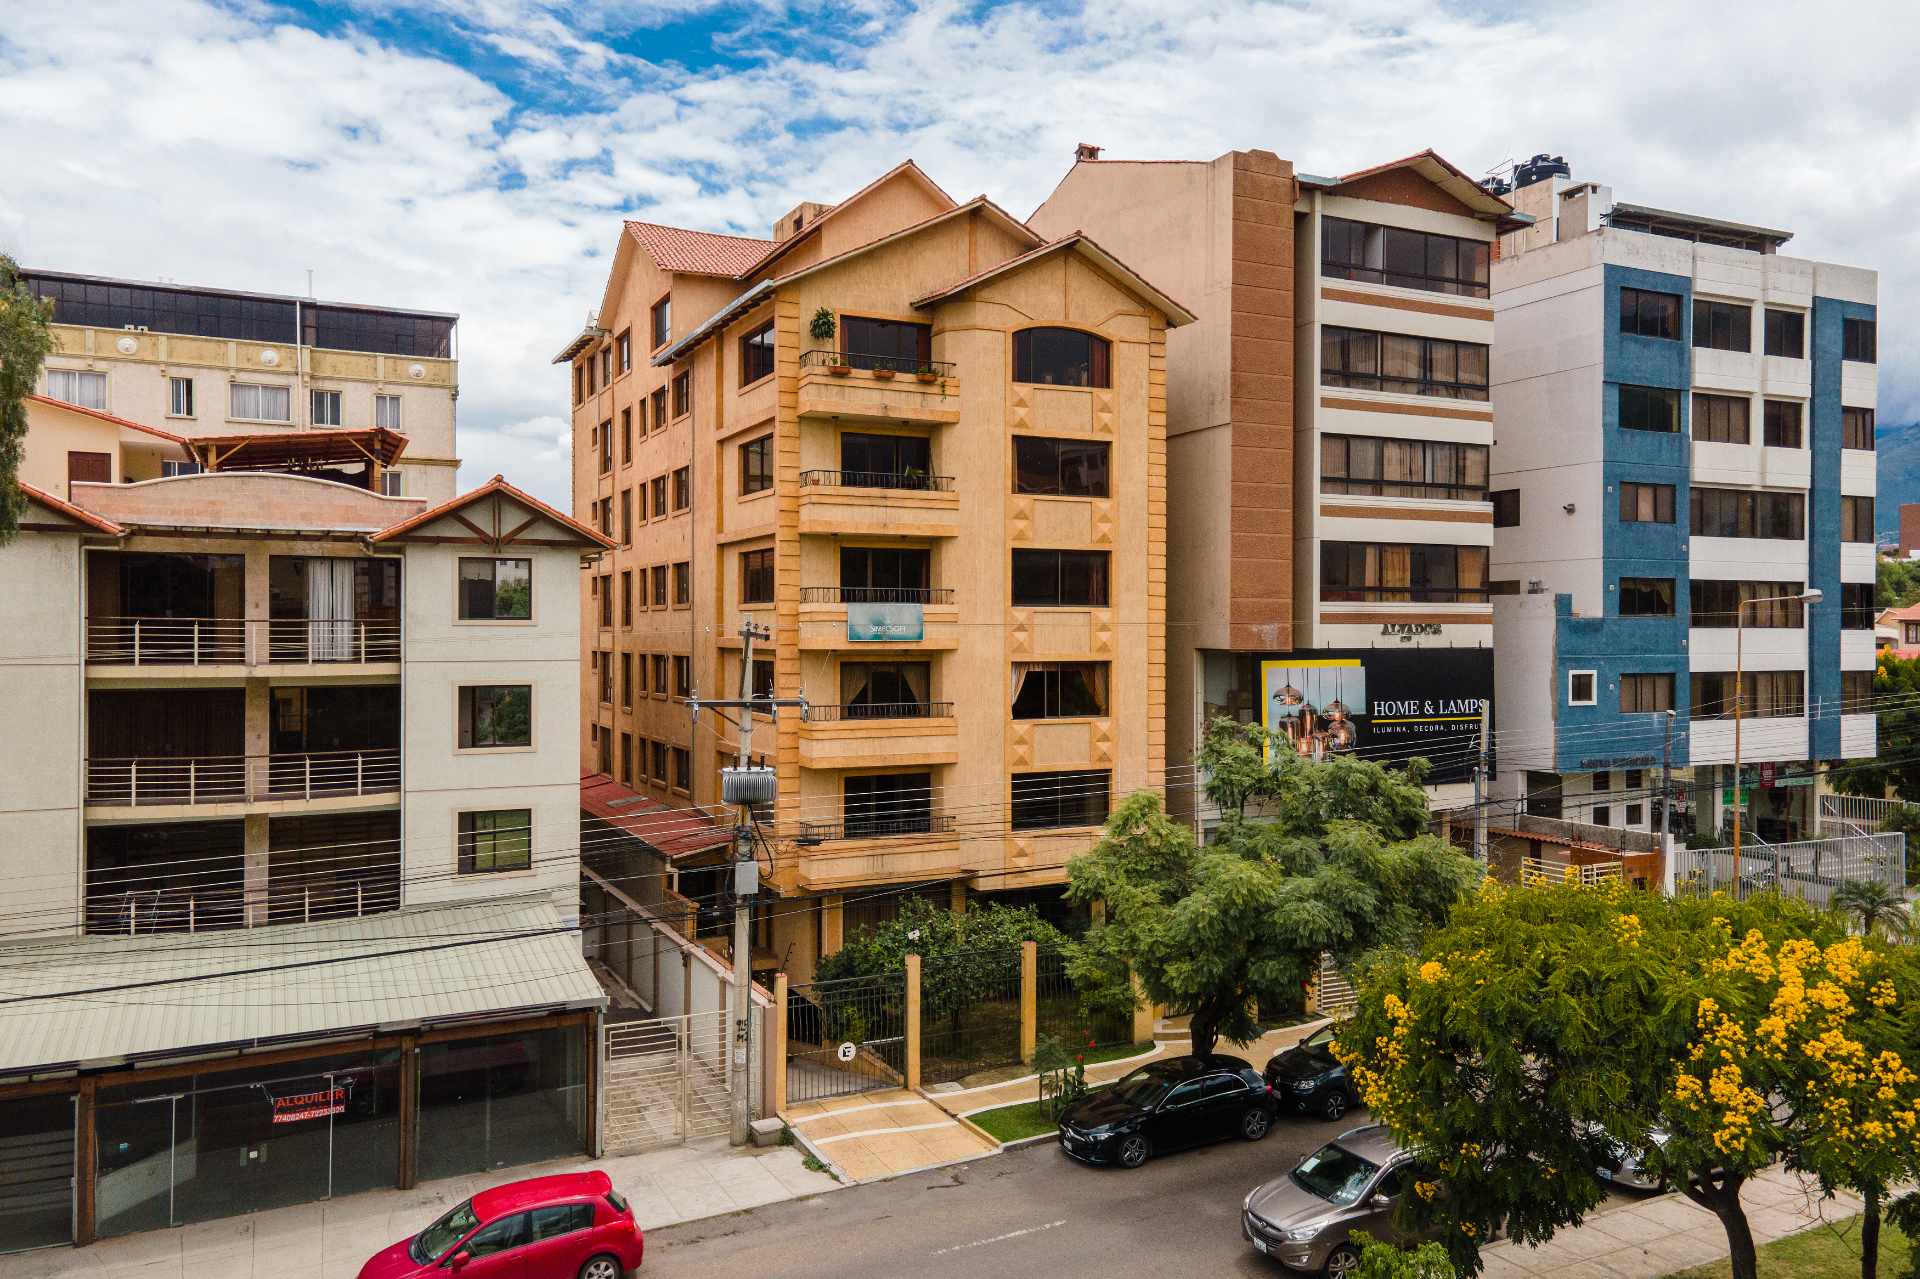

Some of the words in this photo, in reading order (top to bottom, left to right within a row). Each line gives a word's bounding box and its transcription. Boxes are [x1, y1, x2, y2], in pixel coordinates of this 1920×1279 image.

[1373, 700, 1420, 716] HOME
[1424, 700, 1434, 715] &
[1439, 699, 1485, 714] LAMPS
[1451, 723, 1481, 731] DISFRU
[842, 1046, 852, 1058] E
[276, 1089, 344, 1108] ALQUILER
